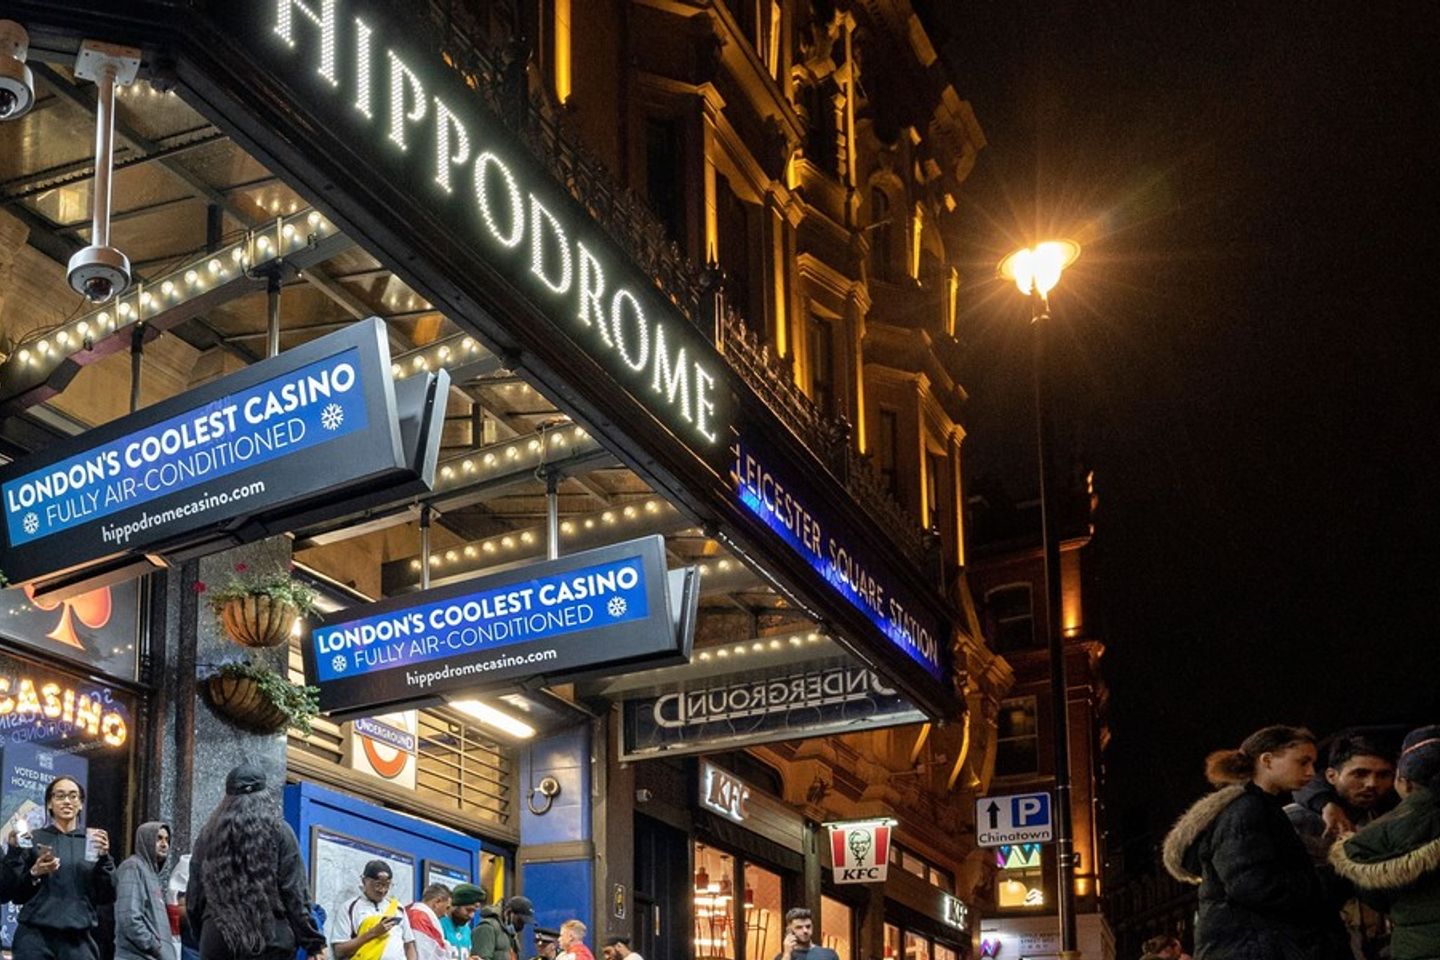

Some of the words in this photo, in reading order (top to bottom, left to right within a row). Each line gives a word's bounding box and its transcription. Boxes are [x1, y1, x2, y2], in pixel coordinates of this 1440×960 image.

[273, 0, 717, 444] HIPPODROME
[7, 447, 121, 513] LONDON'S
[124, 405, 238, 469] COOLEST
[243, 362, 356, 425] CASINO
[46, 489, 101, 527] FULLY
[104, 417, 306, 506] AIR-CONDITIONED
[102, 479, 266, 545] hippodromecasino.com
[735, 443, 822, 559] LEICESTER
[828, 538, 884, 619] SQUARE
[890, 598, 939, 668] STATION
[318, 614, 426, 655] LONDON'S
[429, 588, 534, 631] COOLEST
[539, 566, 639, 606] CASINO
[355, 643, 405, 668] FULLY
[408, 604, 594, 658] AIR-CONDITIONED
[406, 647, 558, 688] hippodromecasino.com
[11, 776, 35, 790] HOUSE
[13, 766, 39, 780] VOTED
[978, 829, 1051, 845] Chinatown
[1018, 798, 1042, 826] P
[842, 867, 882, 881] KFC
